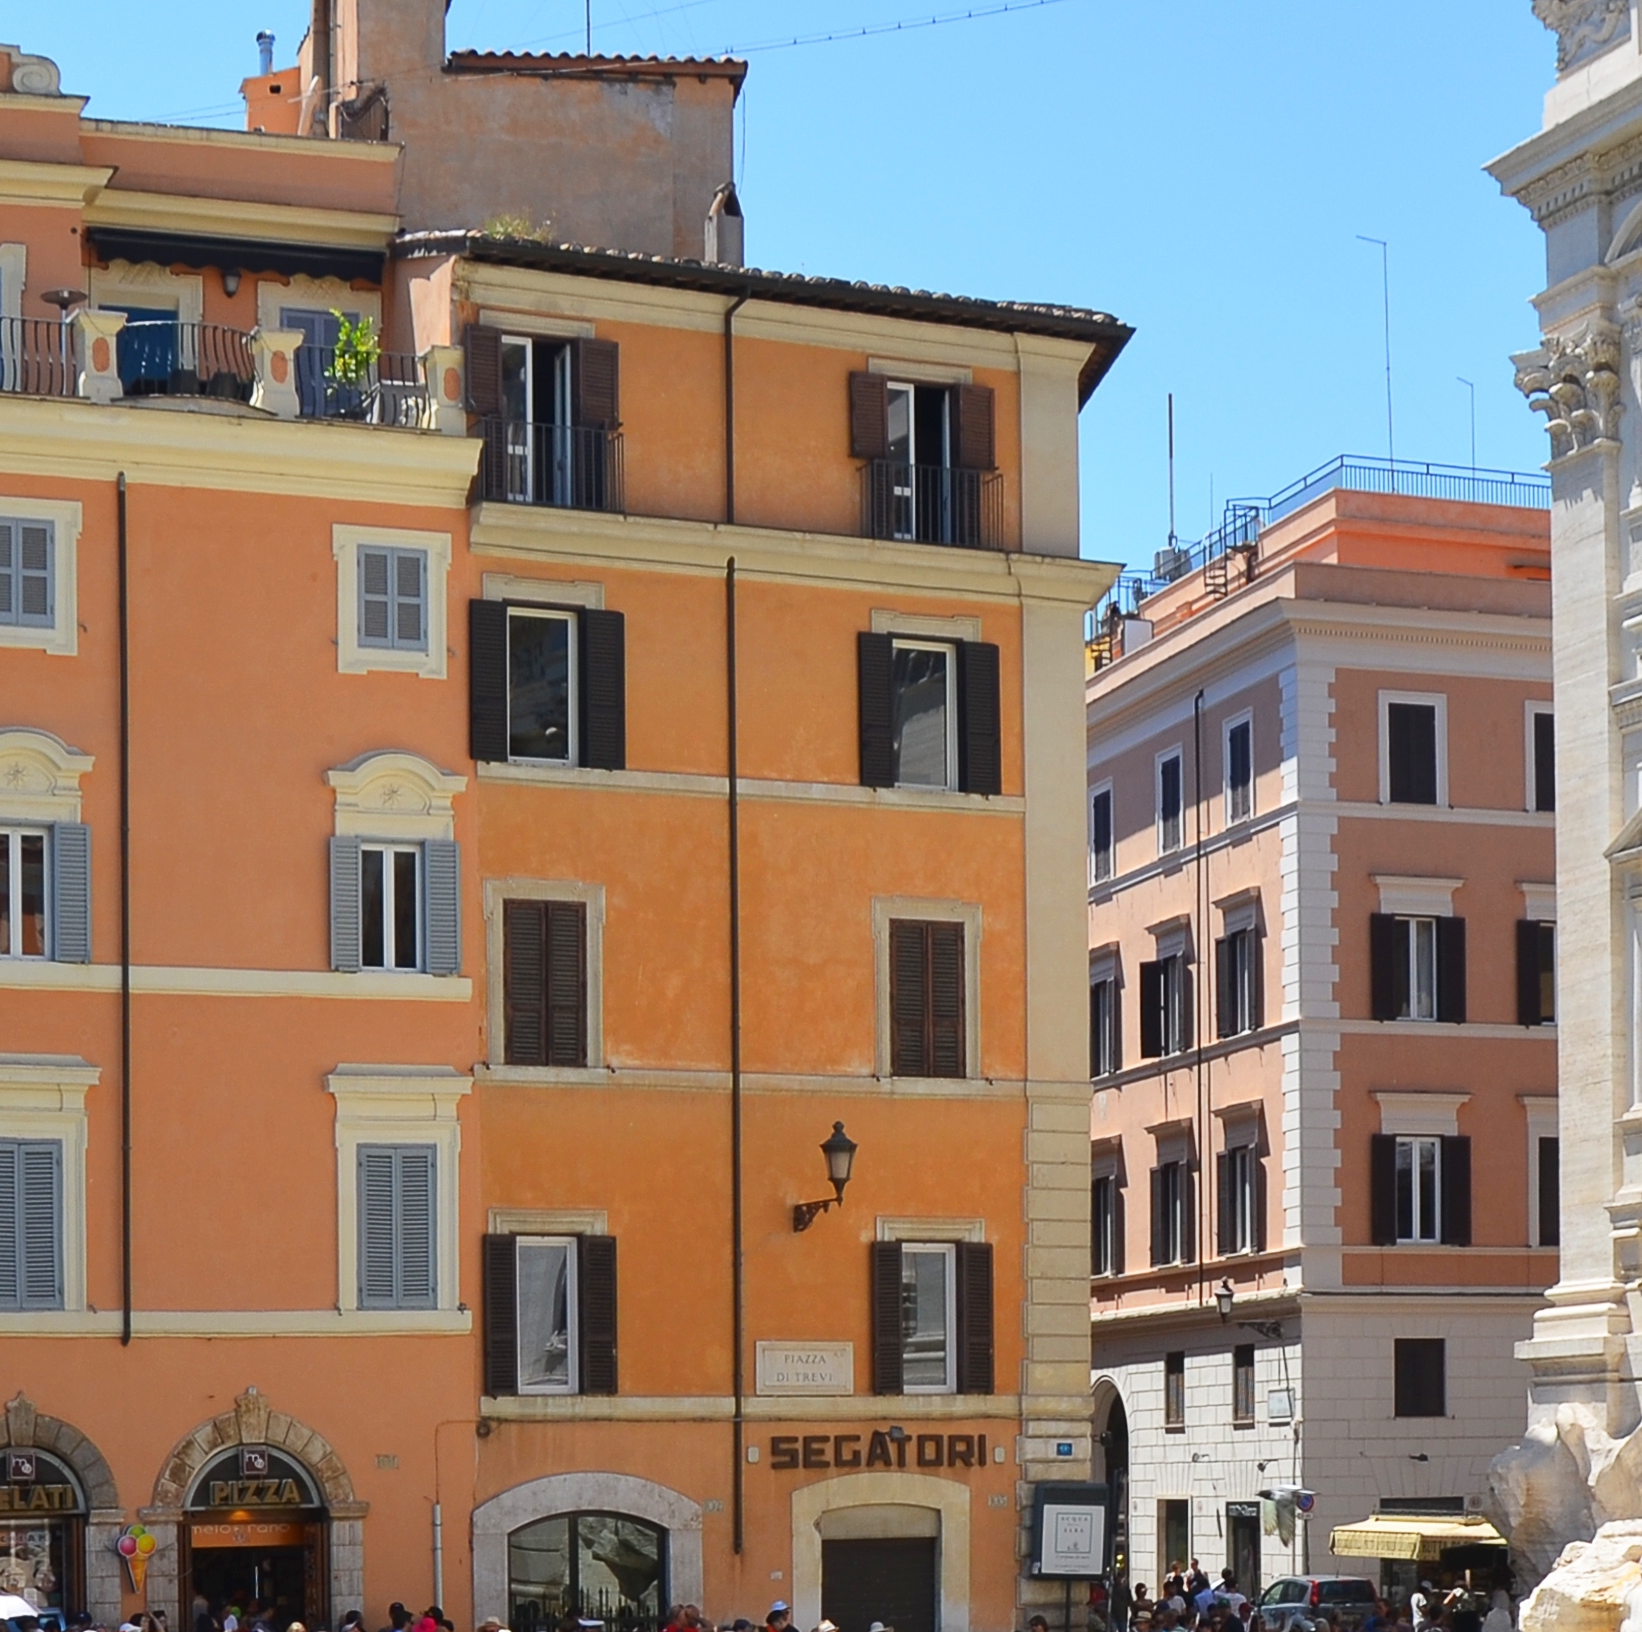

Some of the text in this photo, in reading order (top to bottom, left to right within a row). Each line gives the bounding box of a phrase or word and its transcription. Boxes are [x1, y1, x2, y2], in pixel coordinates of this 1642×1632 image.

[784, 1354, 826, 1364] PIAZZA
[776, 1372, 833, 1382] DI TREVI
[771, 1430, 988, 1469] SEGATORI
[210, 1479, 301, 1505] PIZZA
